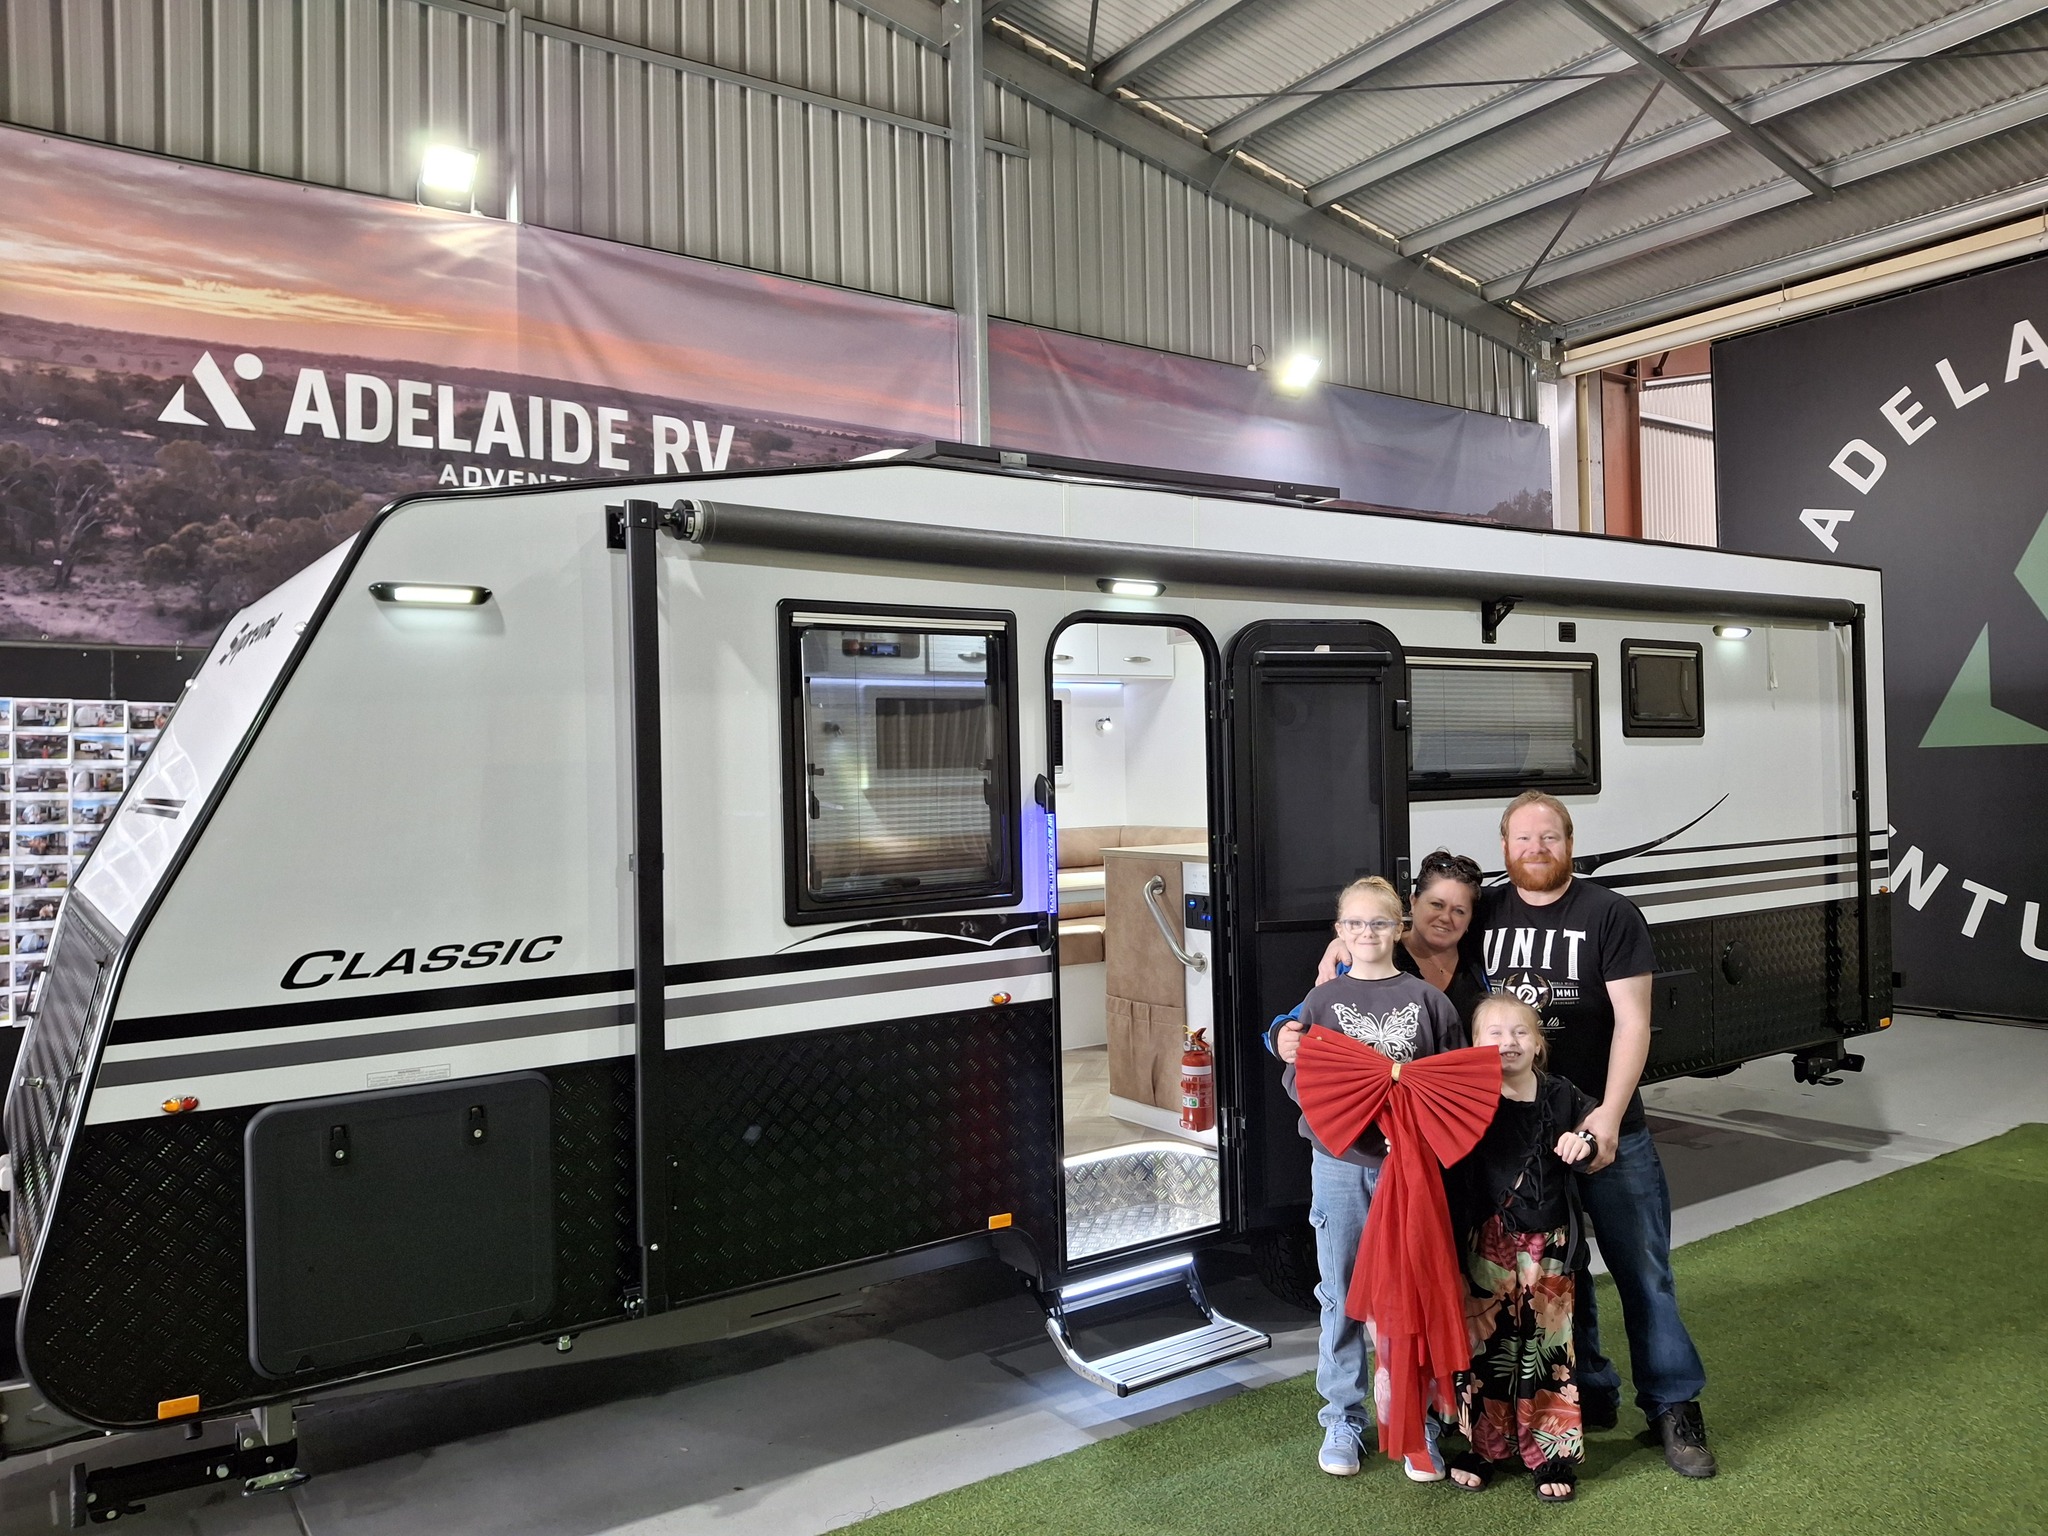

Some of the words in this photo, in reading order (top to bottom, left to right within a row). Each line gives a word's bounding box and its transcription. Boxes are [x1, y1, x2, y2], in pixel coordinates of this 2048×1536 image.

[284, 367, 630, 472] ADELAIDE
[653, 414, 736, 475] RV
[1889, 824, 2048, 962] NTU
[280, 935, 563, 990] CLASSIC
[1483, 927, 1586, 980] UNIT
[1556, 988, 1579, 998] MMII
